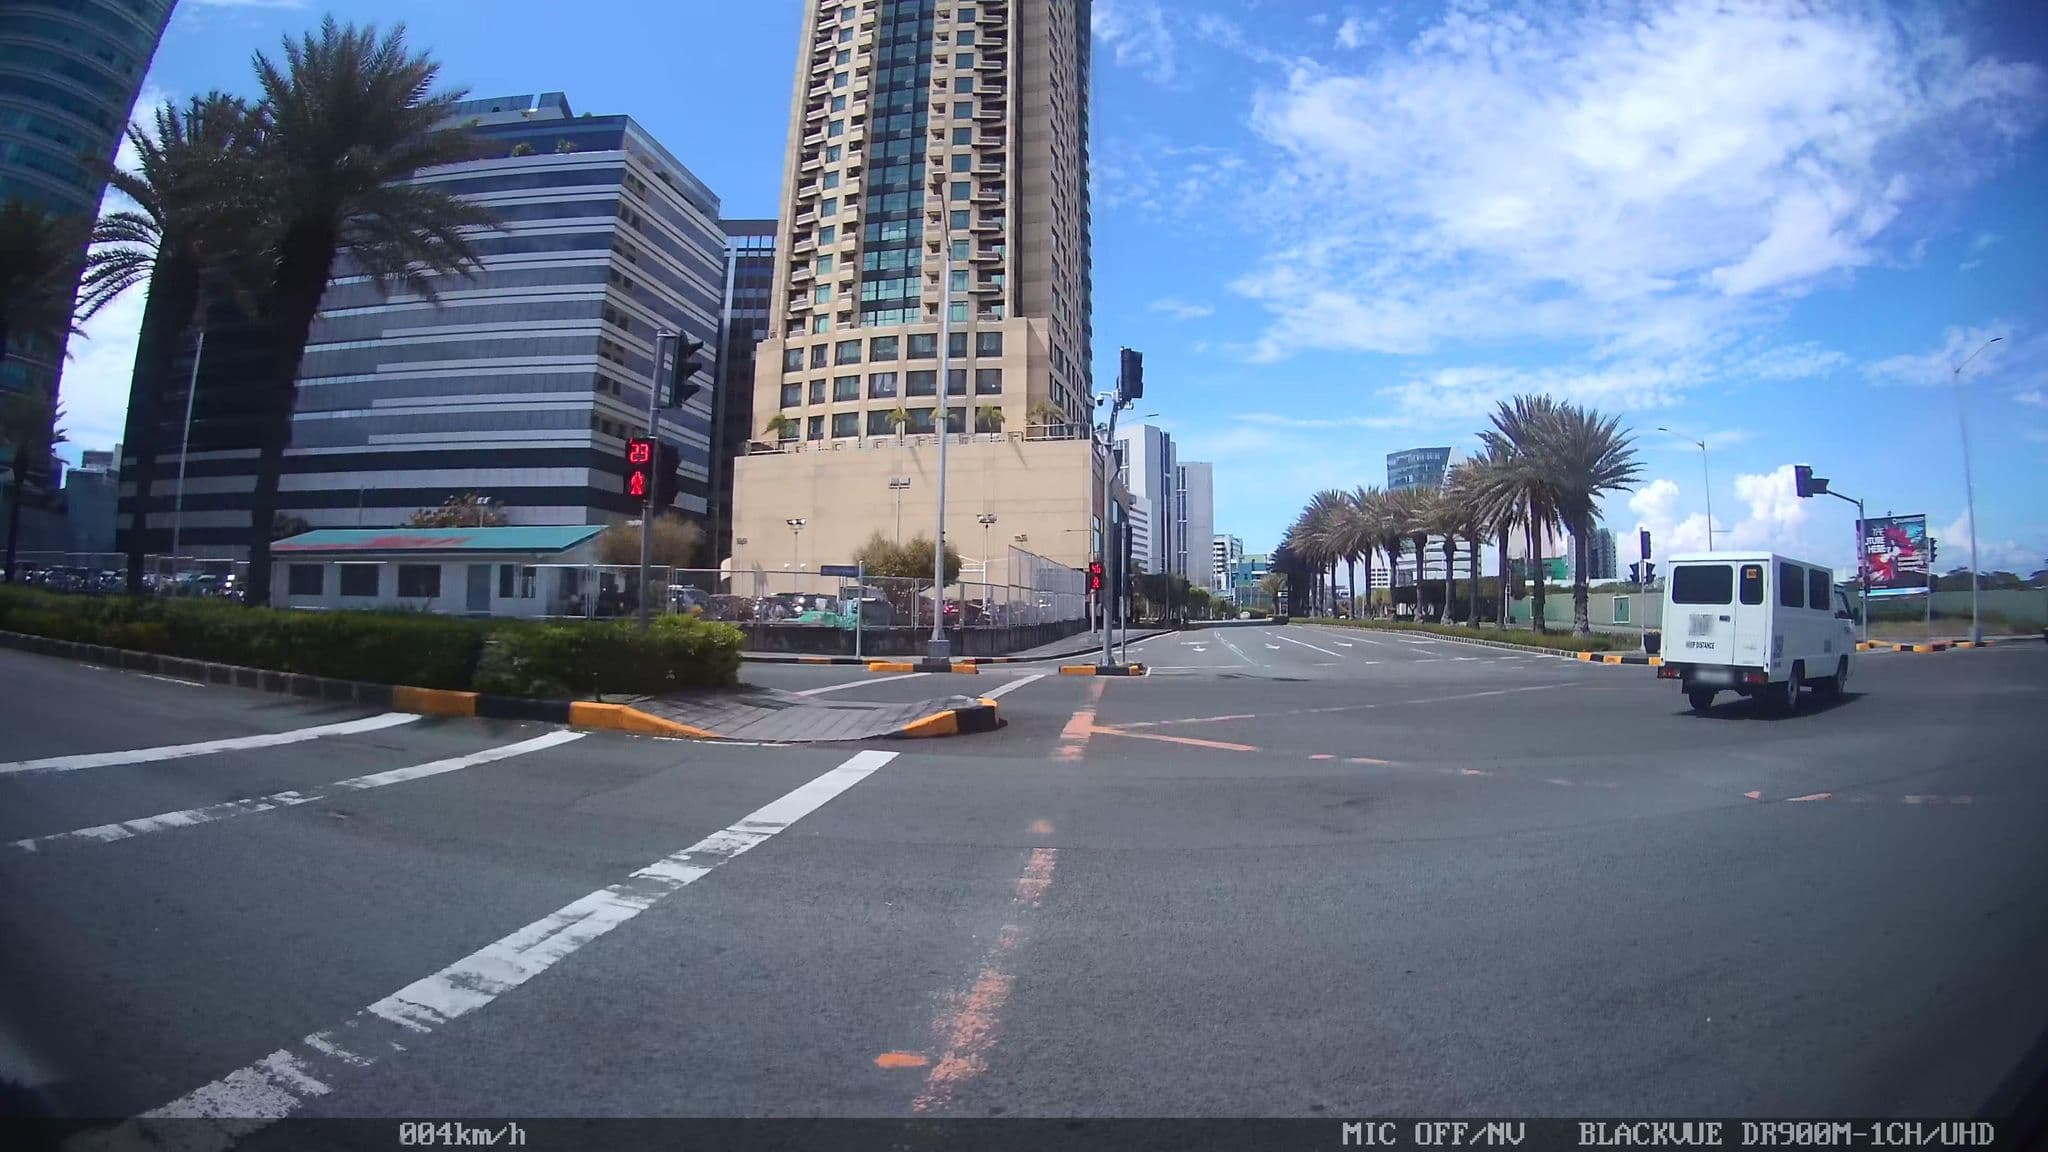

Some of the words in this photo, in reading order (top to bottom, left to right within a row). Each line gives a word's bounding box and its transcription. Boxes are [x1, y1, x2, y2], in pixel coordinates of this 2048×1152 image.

[630, 443, 649, 462] 23
[1864, 536, 1886, 546] UTURE
[1696, 641, 1715, 649] DISTANCE
